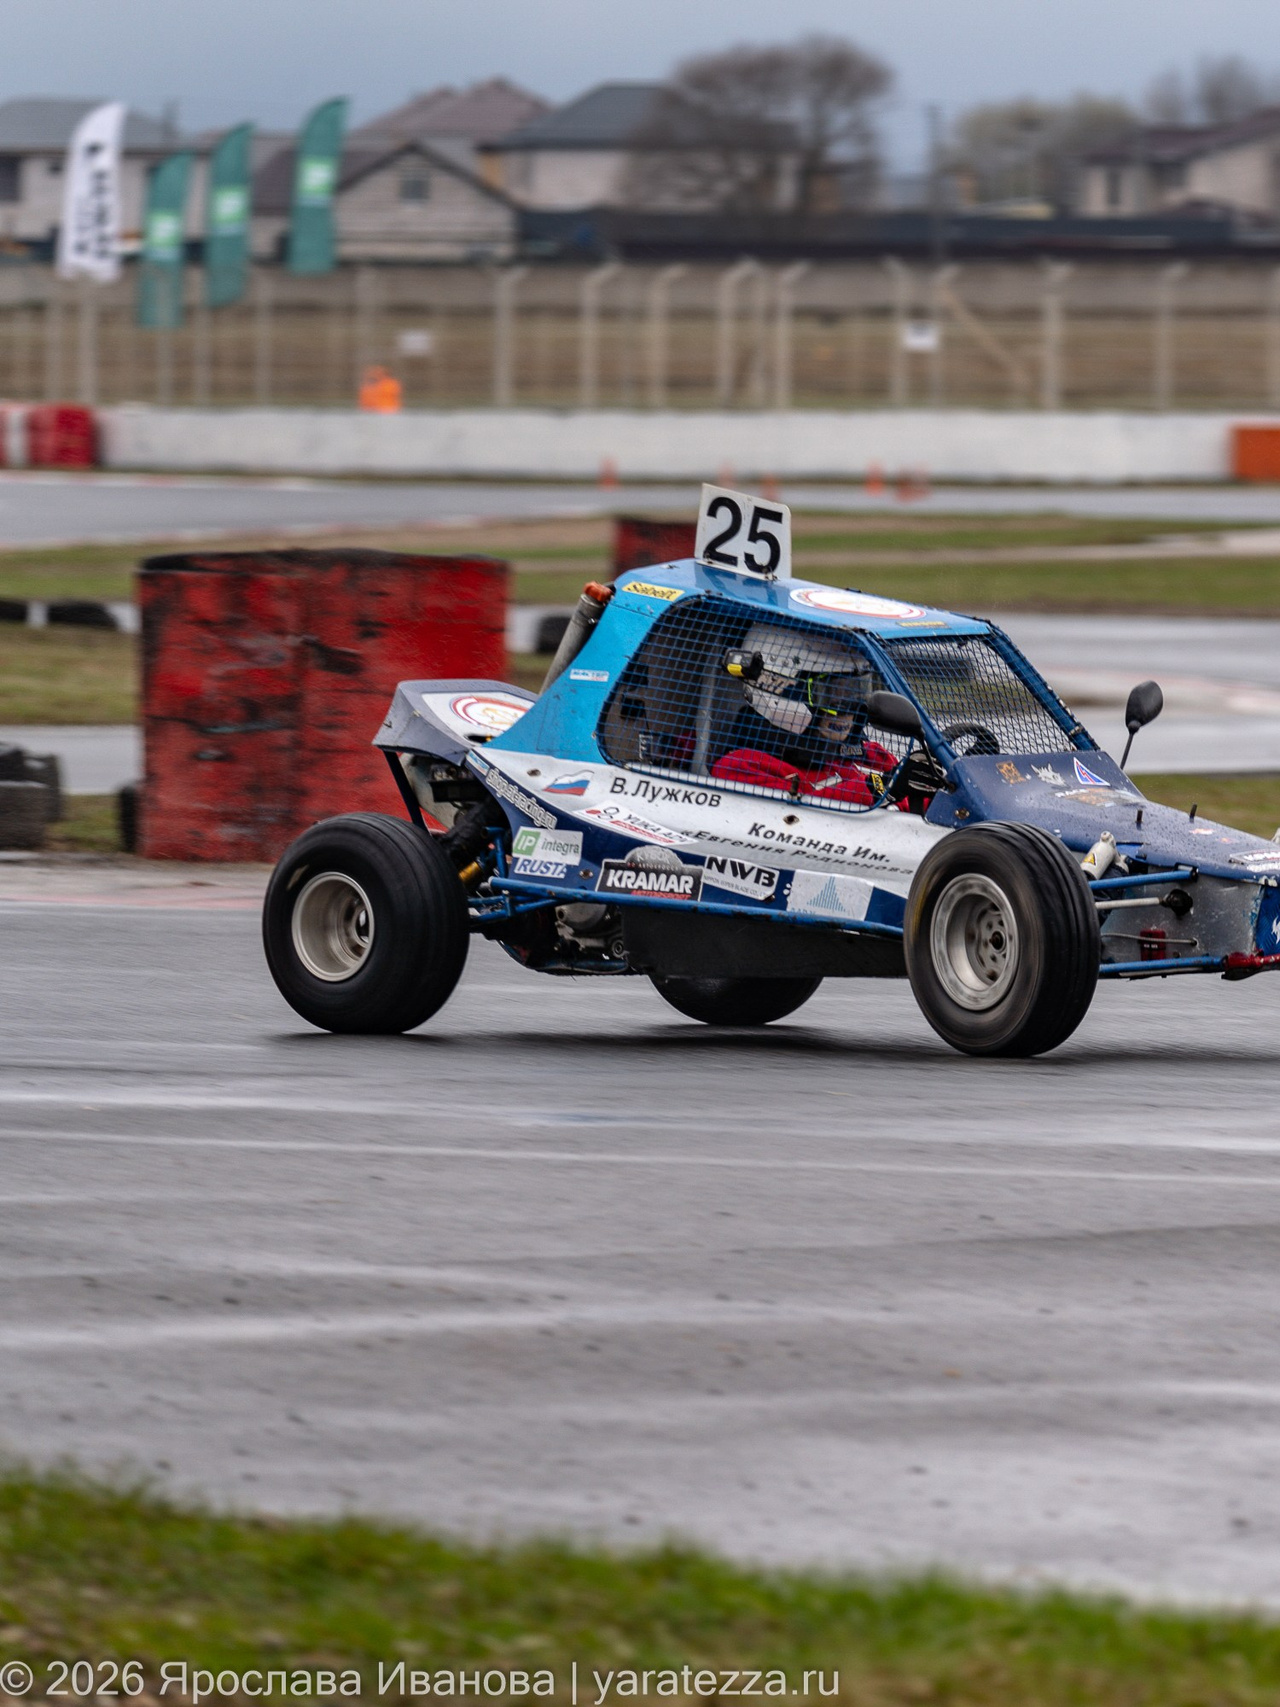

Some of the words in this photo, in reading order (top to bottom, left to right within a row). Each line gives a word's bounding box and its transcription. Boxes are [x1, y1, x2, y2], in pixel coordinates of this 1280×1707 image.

[703, 496, 783, 574] 25
[610, 776, 722, 808] В.Лужков
[516, 833, 535, 851] IP
[541, 839, 580, 855] integra
[748, 822, 847, 856] Команда
[852, 846, 891, 863] Им.
[606, 869, 694, 894] KRAMAR
[706, 857, 776, 888] NWB
